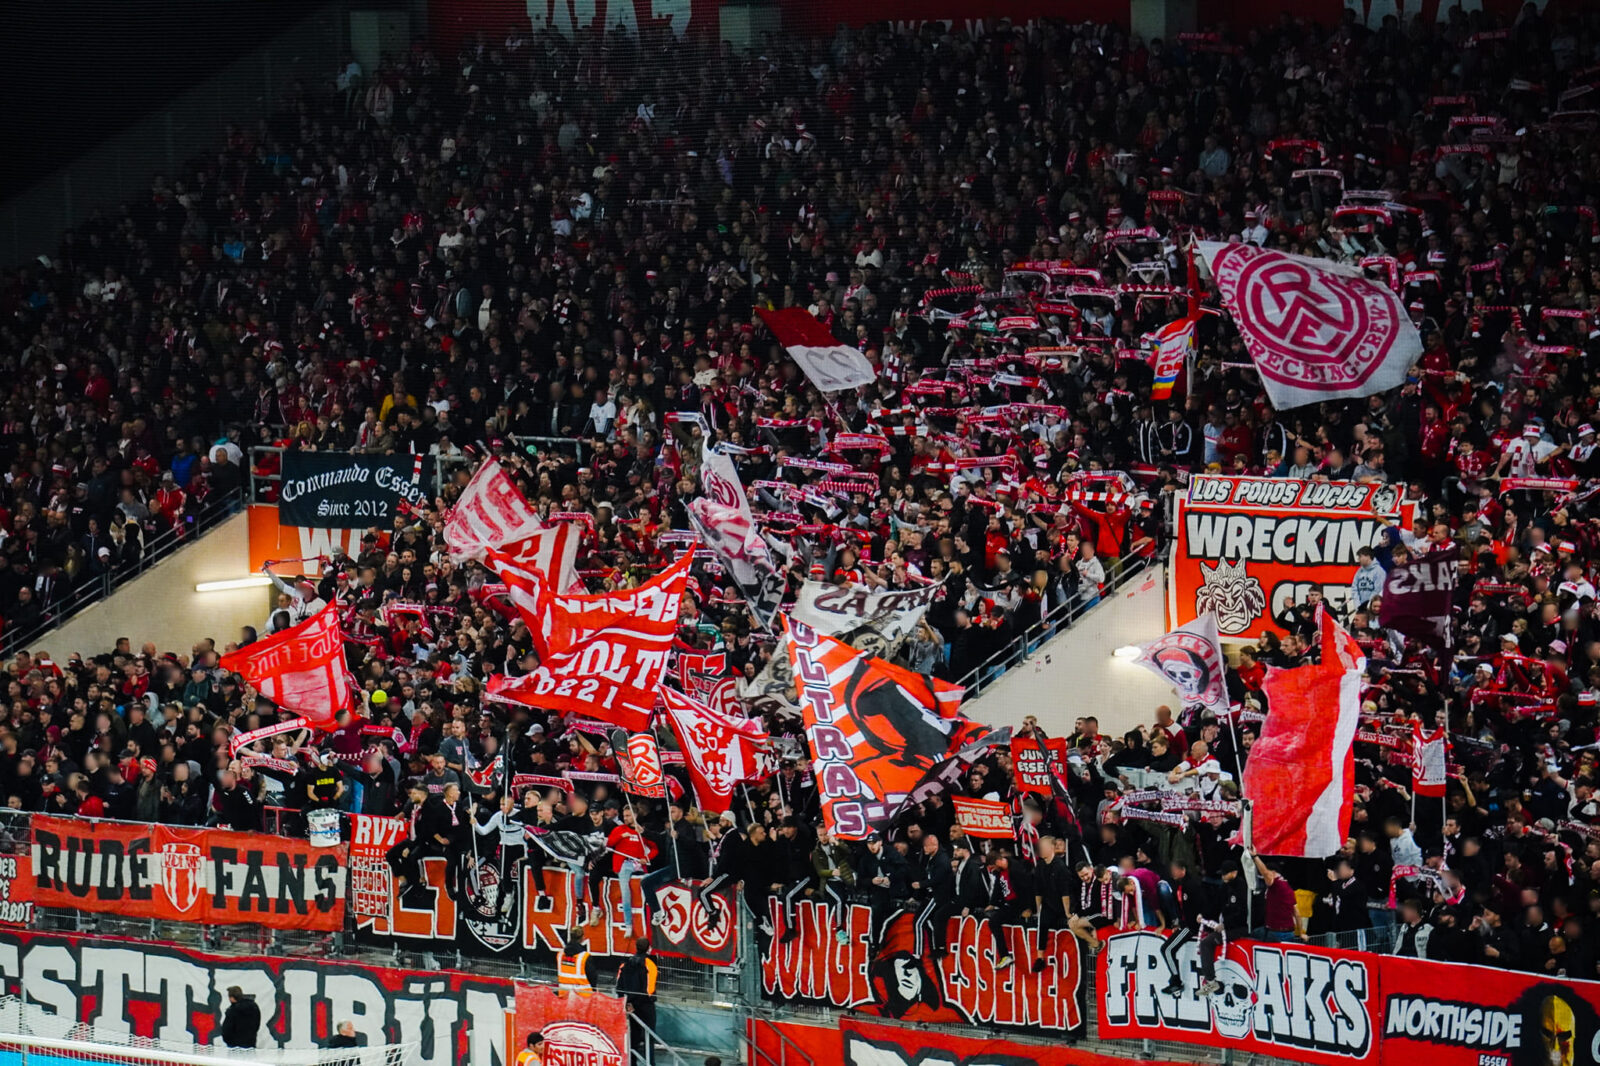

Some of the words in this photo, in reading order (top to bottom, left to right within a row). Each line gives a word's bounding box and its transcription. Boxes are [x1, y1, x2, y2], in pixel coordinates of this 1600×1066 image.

[282, 463, 370, 502] Commando
[1192, 479, 1232, 502] LOS
[1299, 483, 1369, 508] LOCOS
[317, 499, 350, 517] Since
[354, 500, 389, 517] 2012
[355, 815, 405, 846] RVT
[957, 813, 1011, 829] ULTRAS
[0, 857, 17, 878] ER
[36, 829, 152, 901] RUDE
[211, 846, 340, 915] FANS
[762, 896, 875, 1008] JUNGE
[1386, 998, 1523, 1048] NORTHSIDE
[1479, 1054, 1509, 1066] ESSEN
